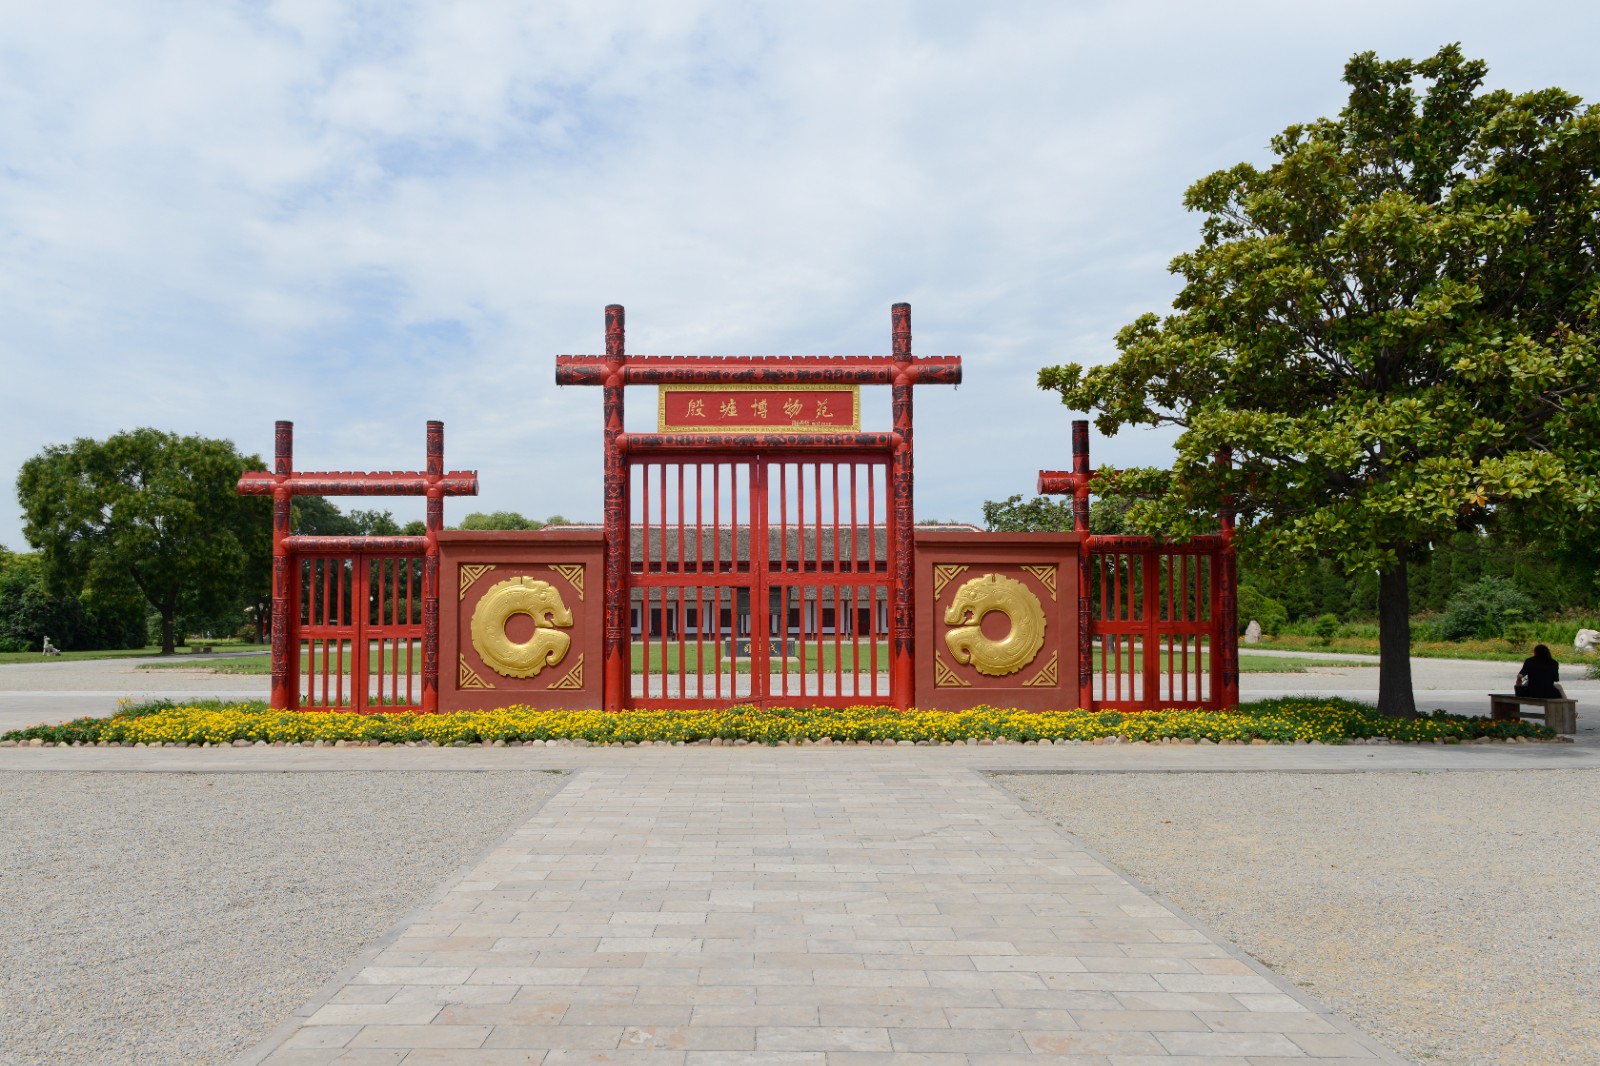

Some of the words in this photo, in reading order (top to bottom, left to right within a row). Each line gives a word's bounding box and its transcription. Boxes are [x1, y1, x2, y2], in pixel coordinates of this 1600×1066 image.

[685, 397, 834, 419] 殷墟博物苑
